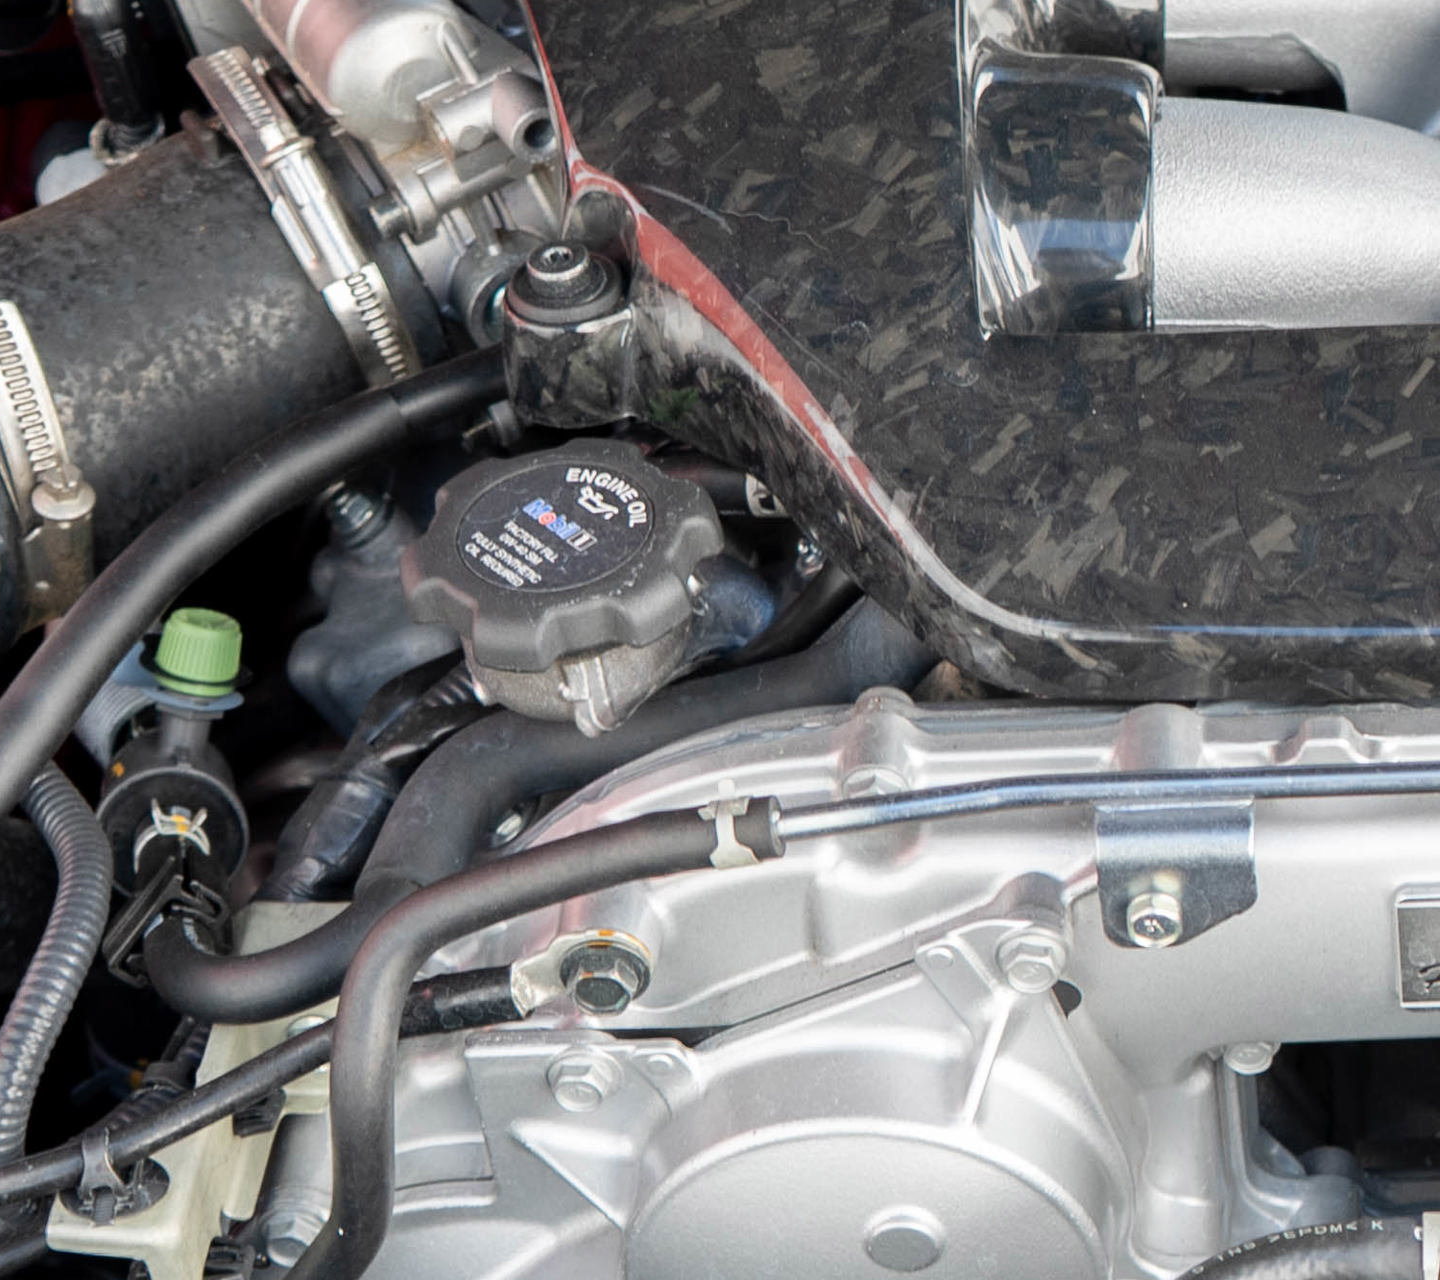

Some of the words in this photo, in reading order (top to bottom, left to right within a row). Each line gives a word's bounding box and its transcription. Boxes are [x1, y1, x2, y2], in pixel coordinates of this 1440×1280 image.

[523, 497, 580, 540] Mobil
[566, 467, 639, 503] ENGINE
[627, 500, 647, 529] OIL
[471, 530, 497, 553] FULLY
[493, 547, 543, 586] SYNTHETIC
[504, 520, 544, 552] FACTORY
[540, 546, 560, 563] FILL
[480, 554, 525, 588] REQUIRED
